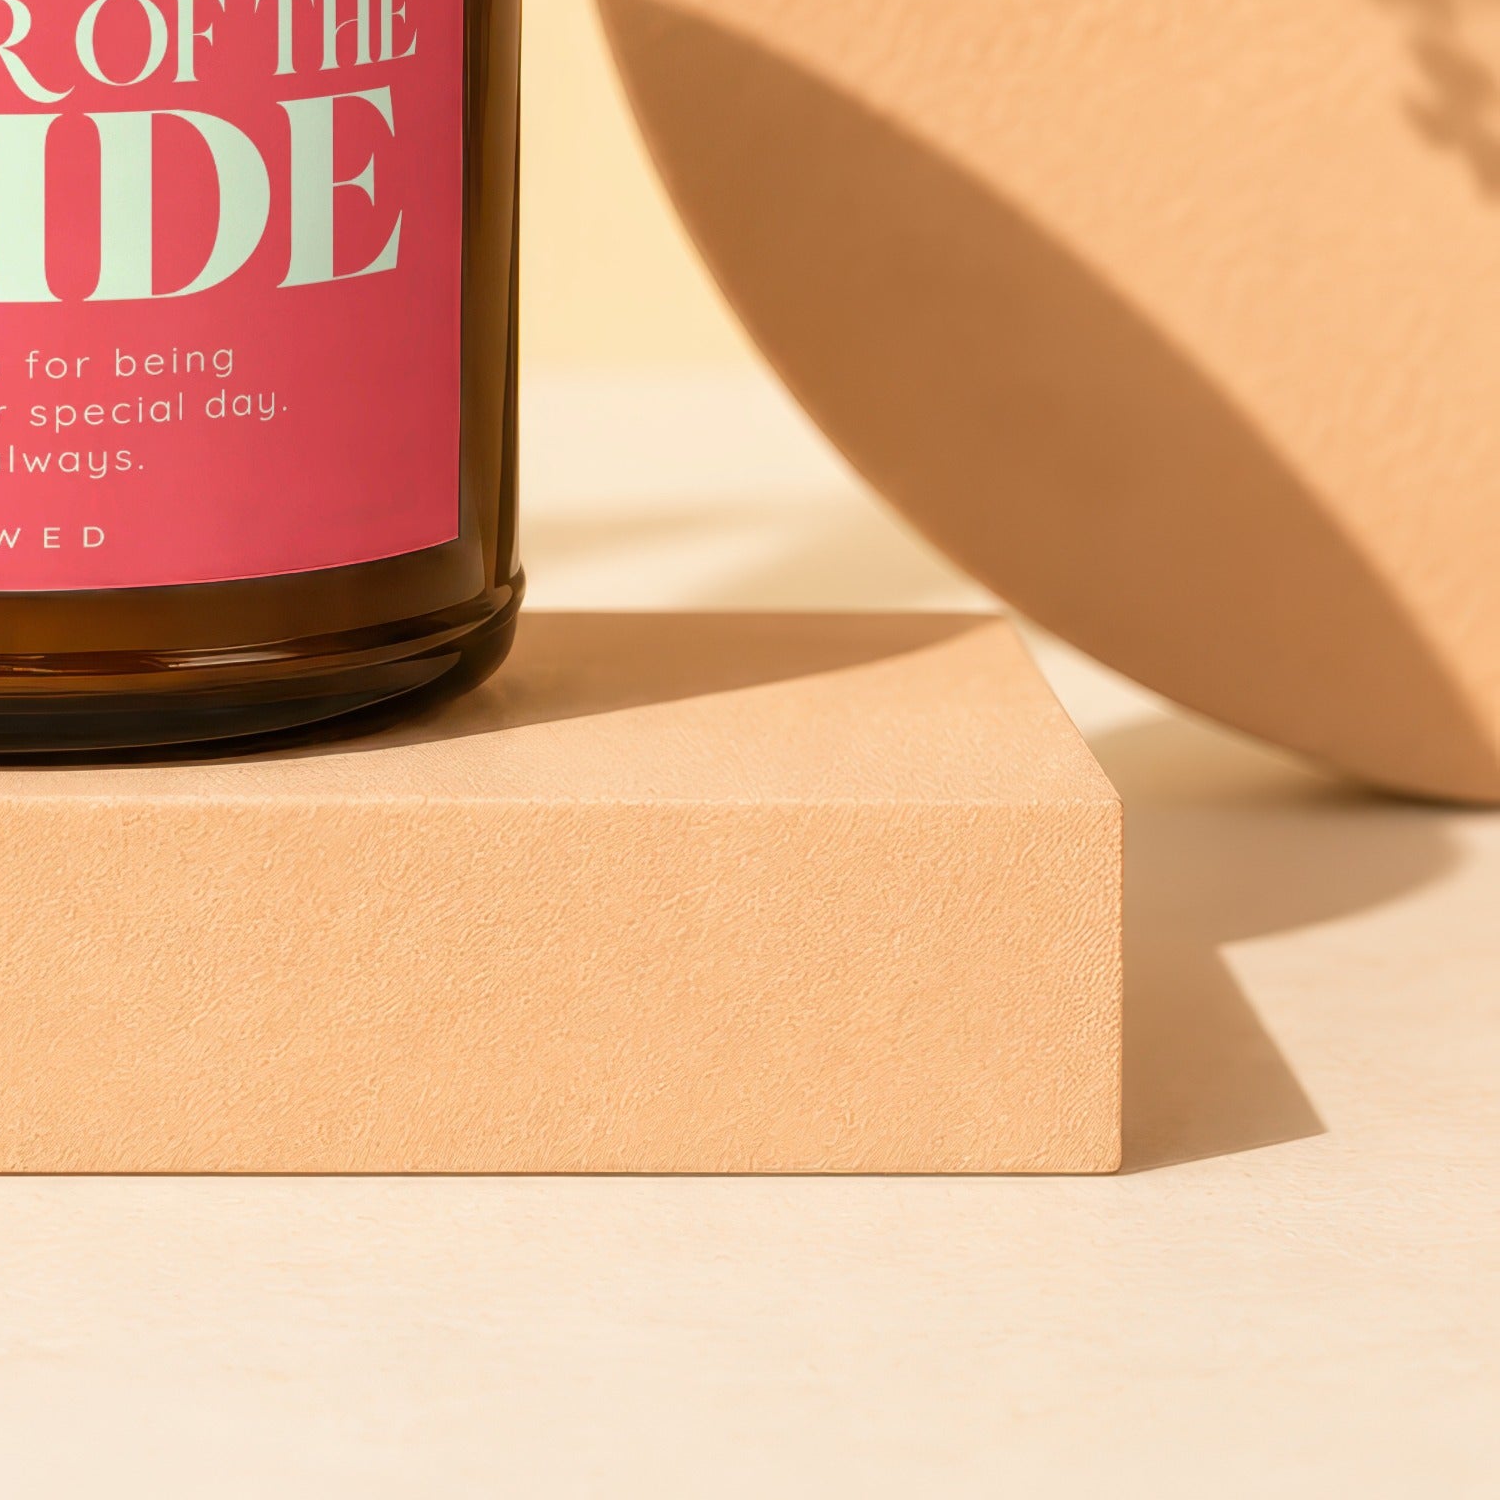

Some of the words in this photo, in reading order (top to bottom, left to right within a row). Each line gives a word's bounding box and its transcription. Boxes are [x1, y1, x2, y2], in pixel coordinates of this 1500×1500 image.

[25, 349, 90, 380] for
[115, 345, 235, 378] being
[29, 391, 184, 434] special
[205, 388, 288, 422] day.
